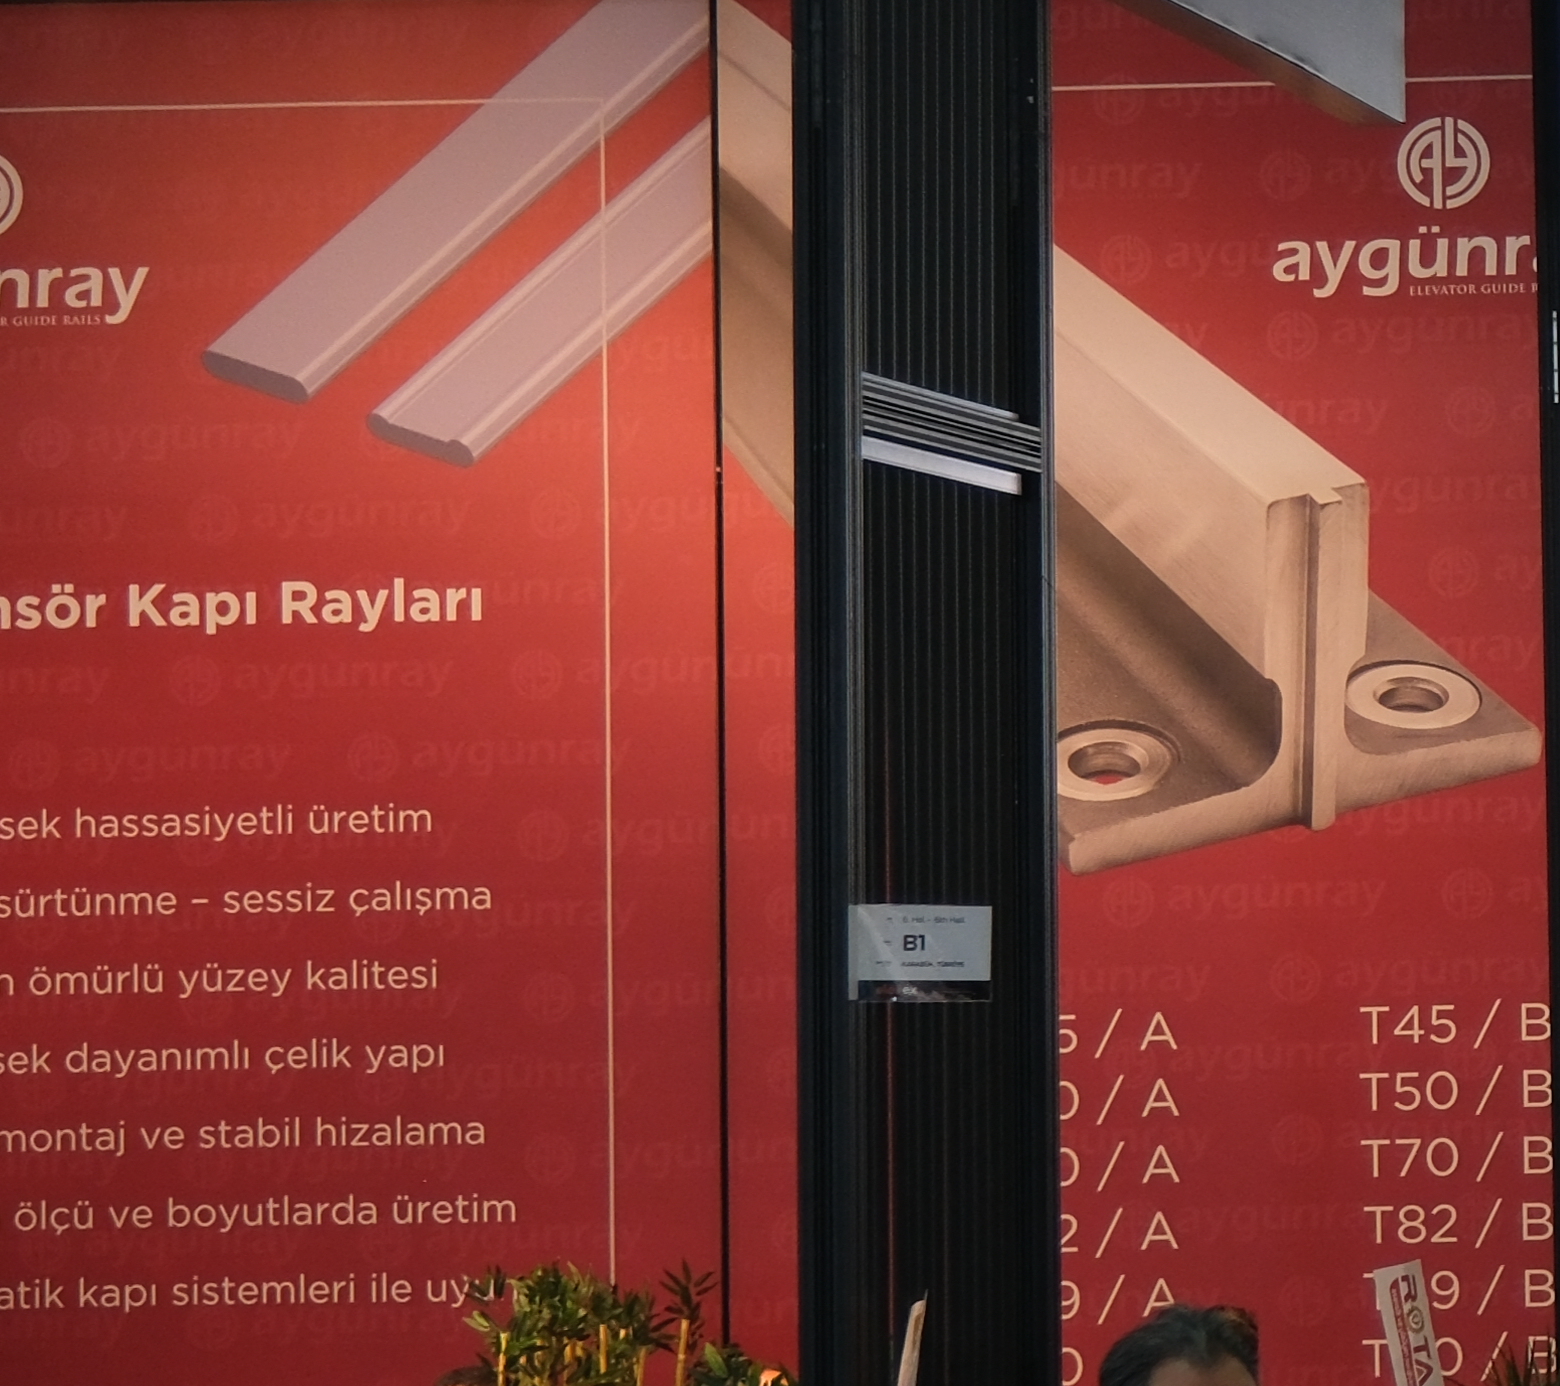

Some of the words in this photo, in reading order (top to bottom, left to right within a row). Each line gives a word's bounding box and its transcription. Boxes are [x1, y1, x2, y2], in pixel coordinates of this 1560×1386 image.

[1272, 225, 1537, 298] aygünr
[1409, 282, 1477, 297] ELEVATOR
[1480, 282, 1527, 295] GUIDE
[12, 315, 57, 327] GUIDE
[63, 314, 100, 326] RAILS
[128, 583, 257, 635] Kapı
[281, 577, 482, 633] Rayları
[75, 803, 294, 842] hassasiyetli
[308, 802, 433, 835] üretim
[223, 882, 335, 914] sessiz
[349, 881, 492, 917] çalışma
[903, 934, 926, 952] B1
[29, 963, 164, 996] ömürlü
[179, 964, 292, 998] yüzey
[306, 959, 438, 991] kalitesi
[1139, 1011, 1178, 1051] A
[1359, 1004, 1457, 1045] T45
[1520, 1003, 1553, 1043] B
[66, 1039, 250, 1078] dayanımlı
[265, 1038, 352, 1075] çelik
[365, 1043, 445, 1074] yapı
[1141, 1078, 1180, 1117] A
[1359, 1070, 1459, 1111] T50
[1522, 1069, 1554, 1108] B
[140, 1126, 185, 1150] ve
[199, 1116, 300, 1149] stabil
[316, 1115, 486, 1148] hizalama
[1142, 1144, 1181, 1184] A
[1360, 1136, 1459, 1178] T70
[1522, 1135, 1554, 1176] B
[14, 1201, 94, 1235] ölçü
[109, 1205, 153, 1229] ve
[168, 1193, 378, 1233] boyutlarda
[393, 1193, 517, 1224] üretim
[1140, 1211, 1179, 1251] A
[1363, 1203, 1459, 1244] T82
[1521, 1201, 1555, 1242] B
[79, 1277, 158, 1314] kapı
[172, 1273, 356, 1307] sistemleri
[371, 1273, 412, 1304] ile
[1524, 1268, 1556, 1309] B
